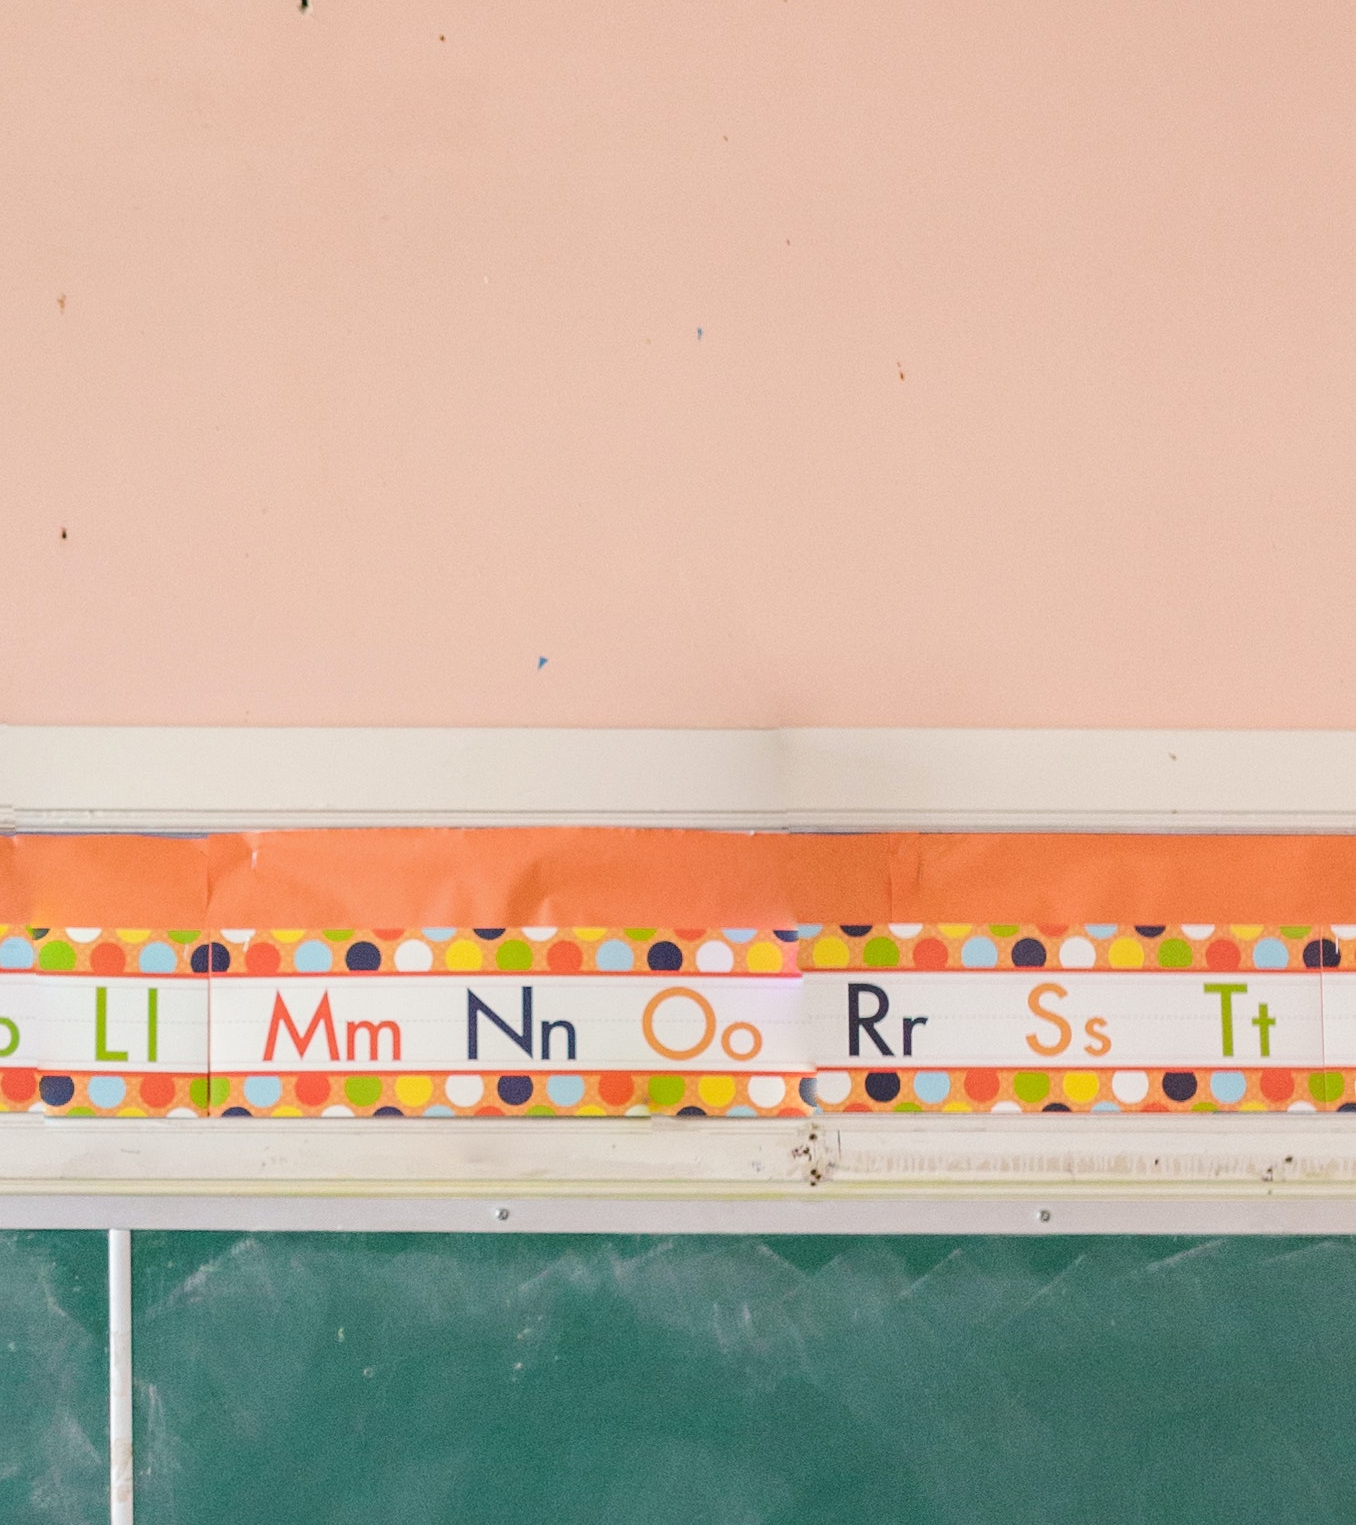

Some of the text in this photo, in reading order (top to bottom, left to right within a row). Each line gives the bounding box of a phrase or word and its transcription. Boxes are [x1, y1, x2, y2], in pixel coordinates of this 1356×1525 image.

[95, 986, 158, 1063] Ll
[263, 992, 401, 1062] Mm
[467, 985, 577, 1061] Nn
[642, 987, 762, 1061] Oo
[847, 982, 928, 1057] Rr
[1027, 983, 1111, 1056] Ss
[1203, 983, 1276, 1057] Tt
